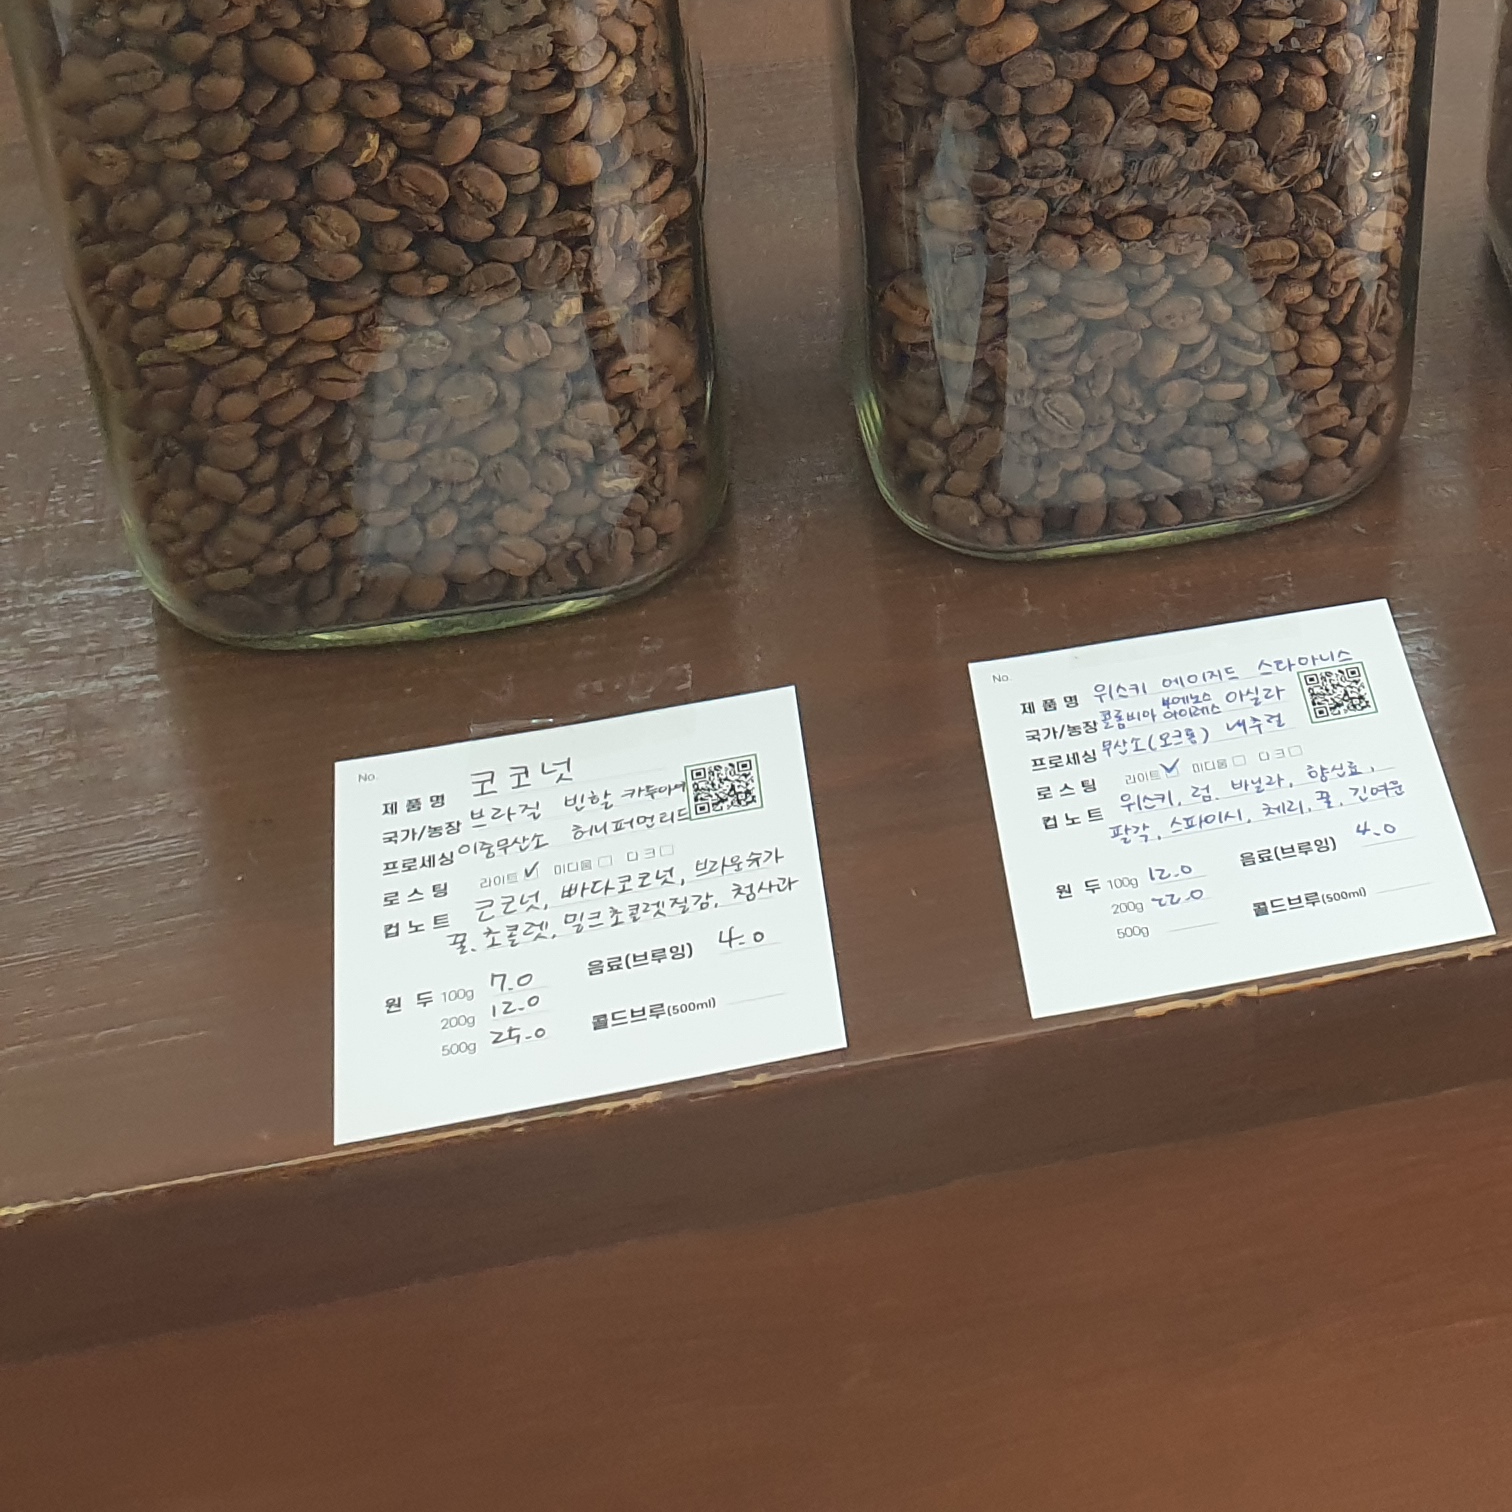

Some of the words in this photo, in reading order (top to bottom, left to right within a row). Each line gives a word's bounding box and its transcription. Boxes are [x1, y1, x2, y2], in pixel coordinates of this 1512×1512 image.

[1093, 682, 1148, 704] 위스키
[1161, 666, 1240, 688] 에이지드
[1257, 649, 1353, 676] 스타아니스
[1025, 720, 1098, 743] 국가/농장
[1099, 708, 1157, 730] 콜롬비아
[470, 756, 573, 797] 코코넛
[1031, 748, 1097, 772] 프로세싱
[1125, 770, 1161, 785] 라이트
[1191, 758, 1228, 774] 미디움
[382, 820, 462, 845] 국가/농장
[470, 800, 541, 829] 브라질
[382, 851, 454, 876] 프로세싱
[457, 832, 549, 860] 이중무산소
[479, 872, 519, 889] 라이트
[553, 859, 593, 876] 미디움
[1106, 876, 1139, 890] 100g
[1148, 864, 1193, 882] 12.0
[1239, 836, 1337, 867] 음료(브루잉)
[731, 876, 799, 902] 청사과
[1111, 900, 1145, 915] 200g
[1116, 925, 1150, 939] 500g
[1252, 886, 1367, 918] 콜드브루(500ml)
[441, 988, 475, 1003] 100g
[587, 942, 693, 976] 음료(브루잉)
[440, 1014, 476, 1031] 200g
[441, 1041, 477, 1057] 500g
[591, 996, 716, 1031] 콜드브루(500ml)
